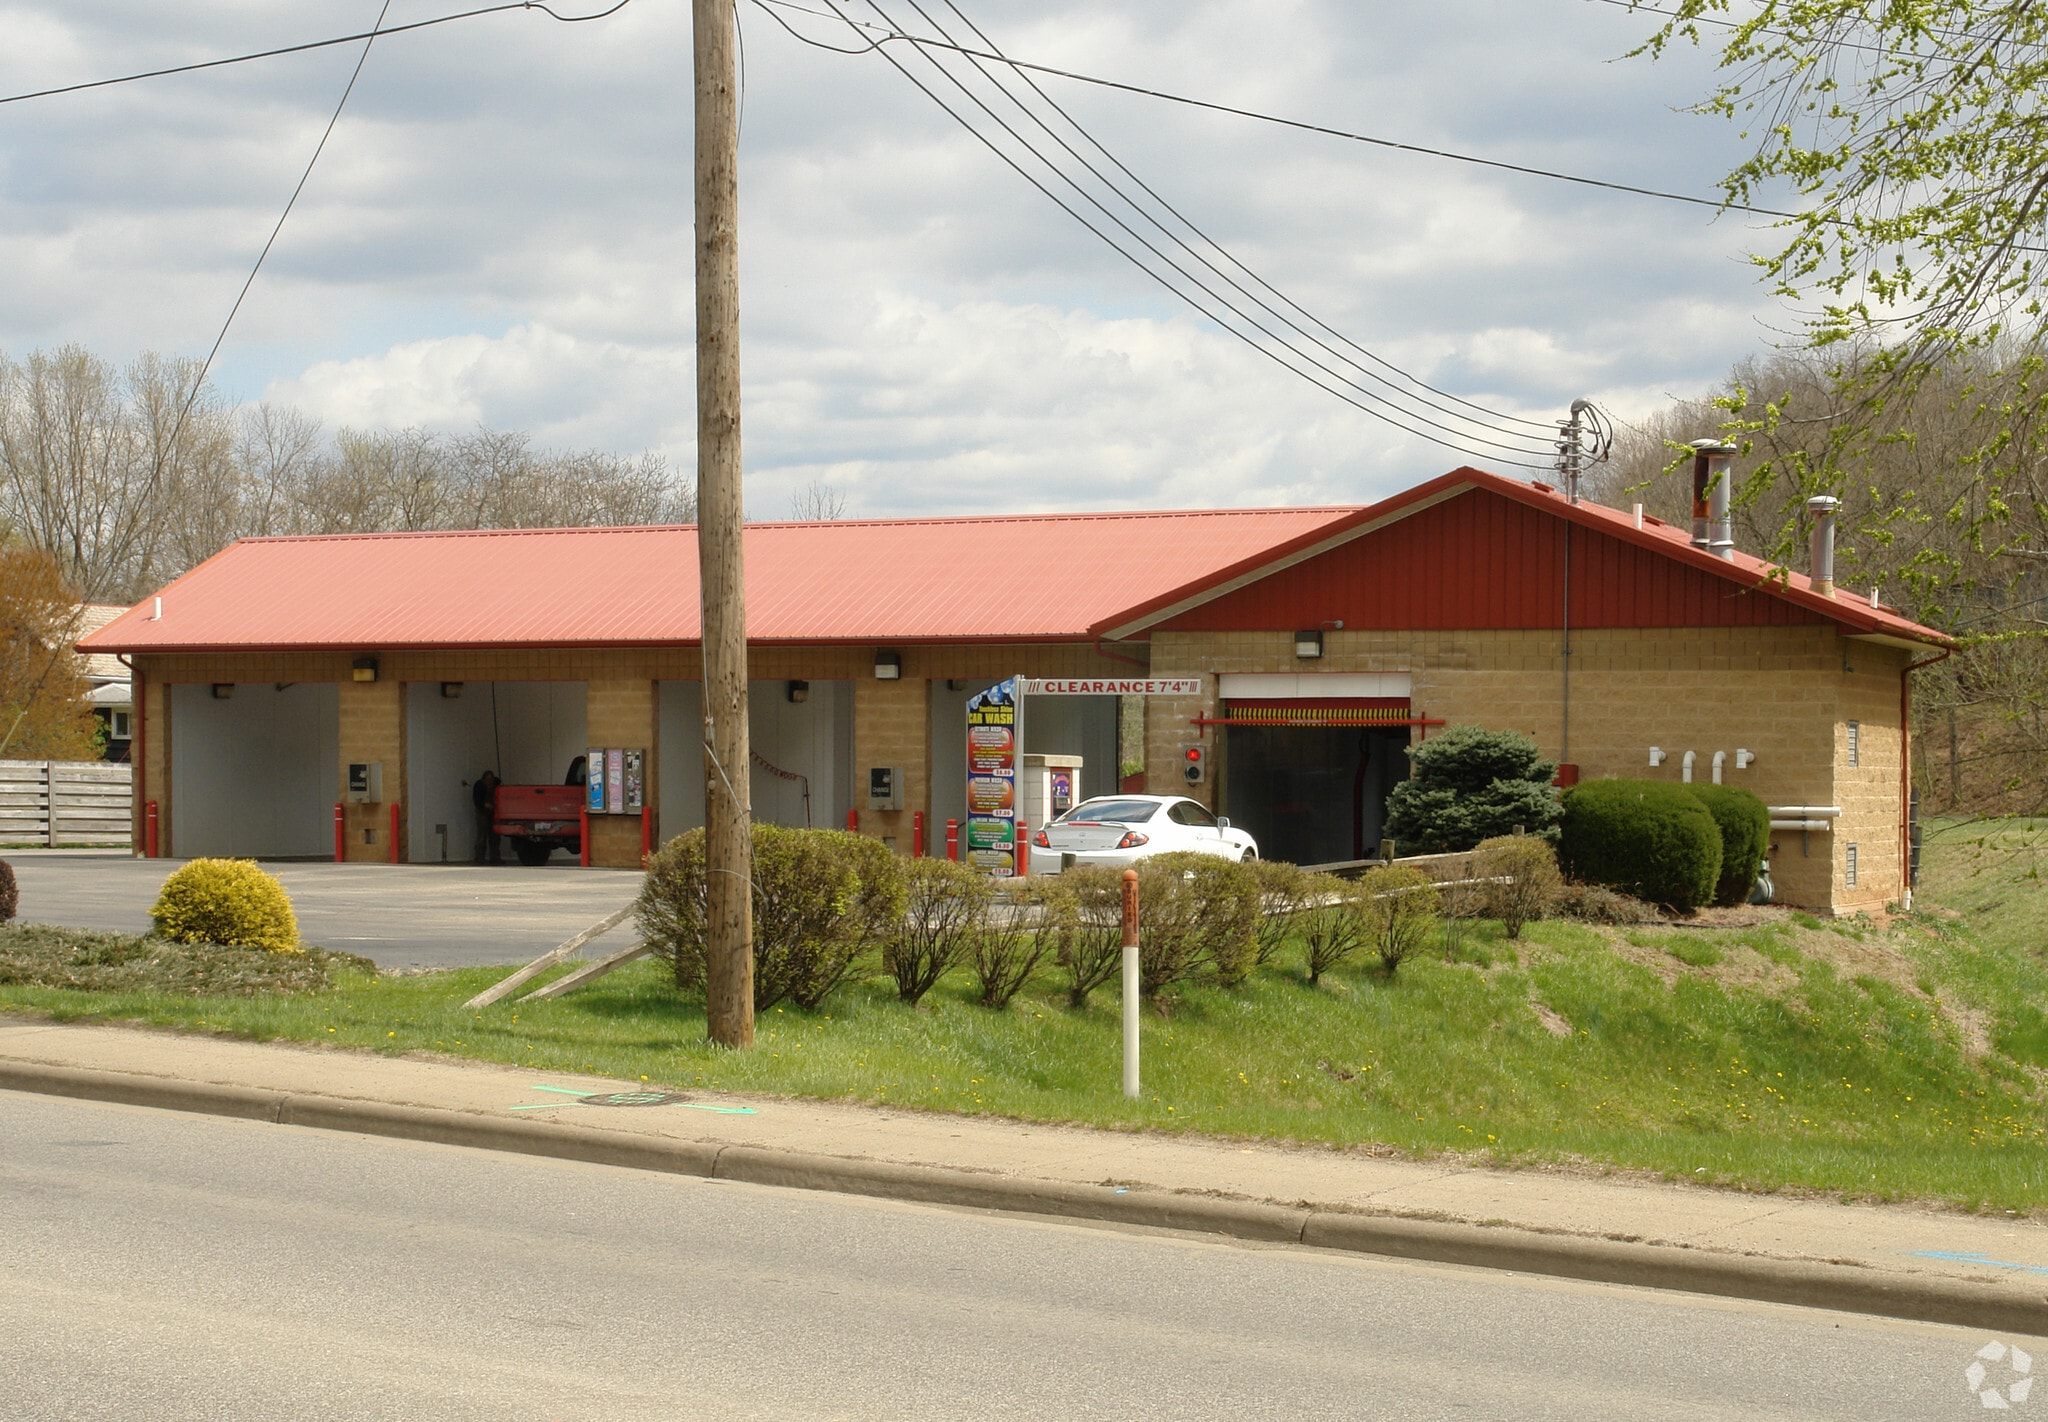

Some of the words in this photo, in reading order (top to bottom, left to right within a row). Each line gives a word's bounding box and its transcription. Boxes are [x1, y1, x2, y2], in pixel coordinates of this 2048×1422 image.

[1045, 681, 1155, 693] CLEARANCE
[1159, 681, 1188, 693] 7'4"
[968, 712, 983, 724] CAR
[985, 712, 1014, 725] WASH
